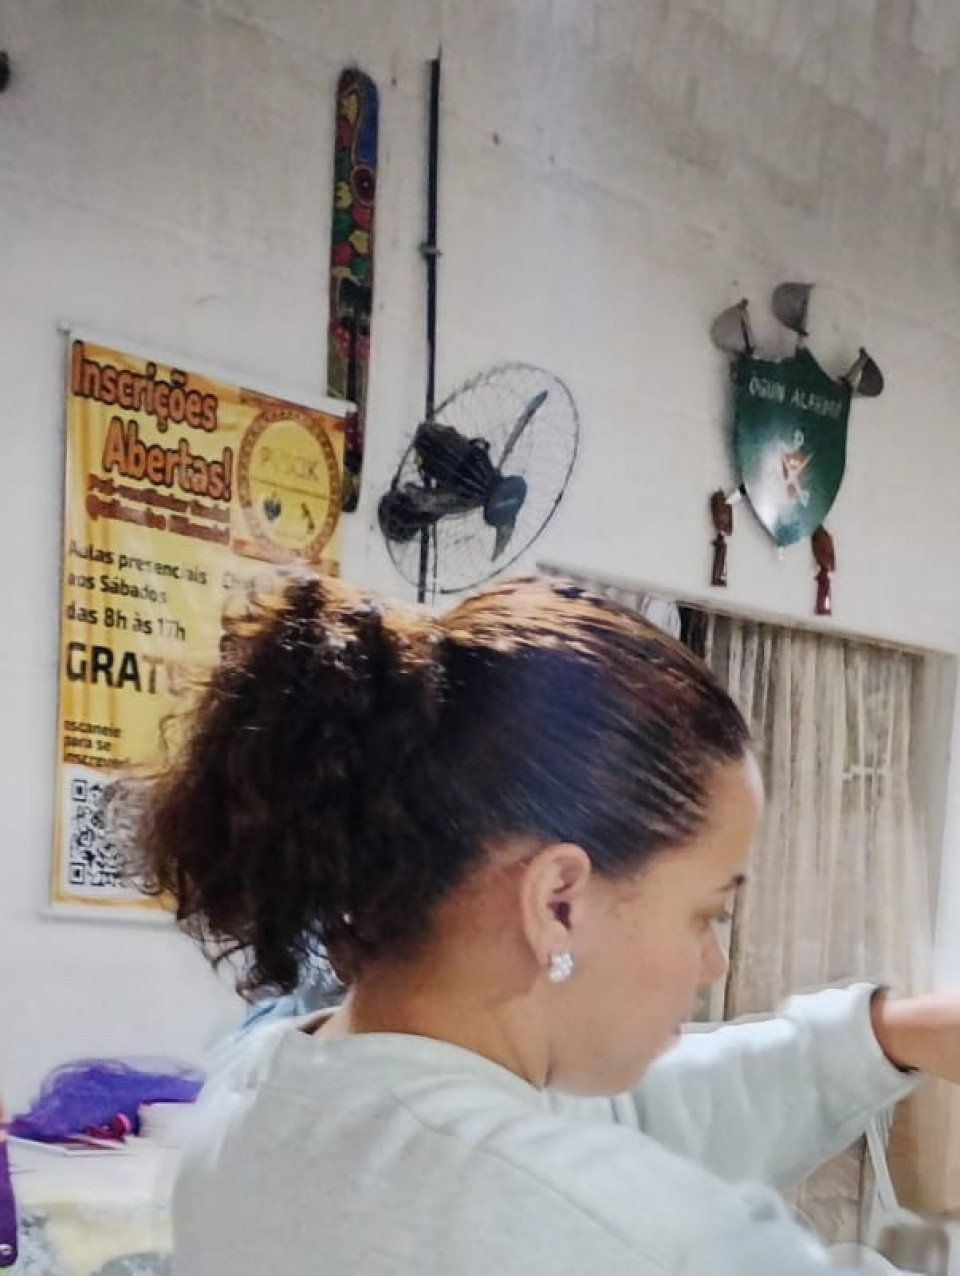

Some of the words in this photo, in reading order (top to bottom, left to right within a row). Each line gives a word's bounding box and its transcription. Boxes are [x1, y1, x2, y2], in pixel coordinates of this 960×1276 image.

[73, 339, 218, 433] Inscrições
[102, 415, 233, 502] Abertas!
[118, 554, 208, 585] preencais
[66, 601, 98, 625] das
[104, 607, 127, 630] 8h
[157, 617, 186, 641] 17h
